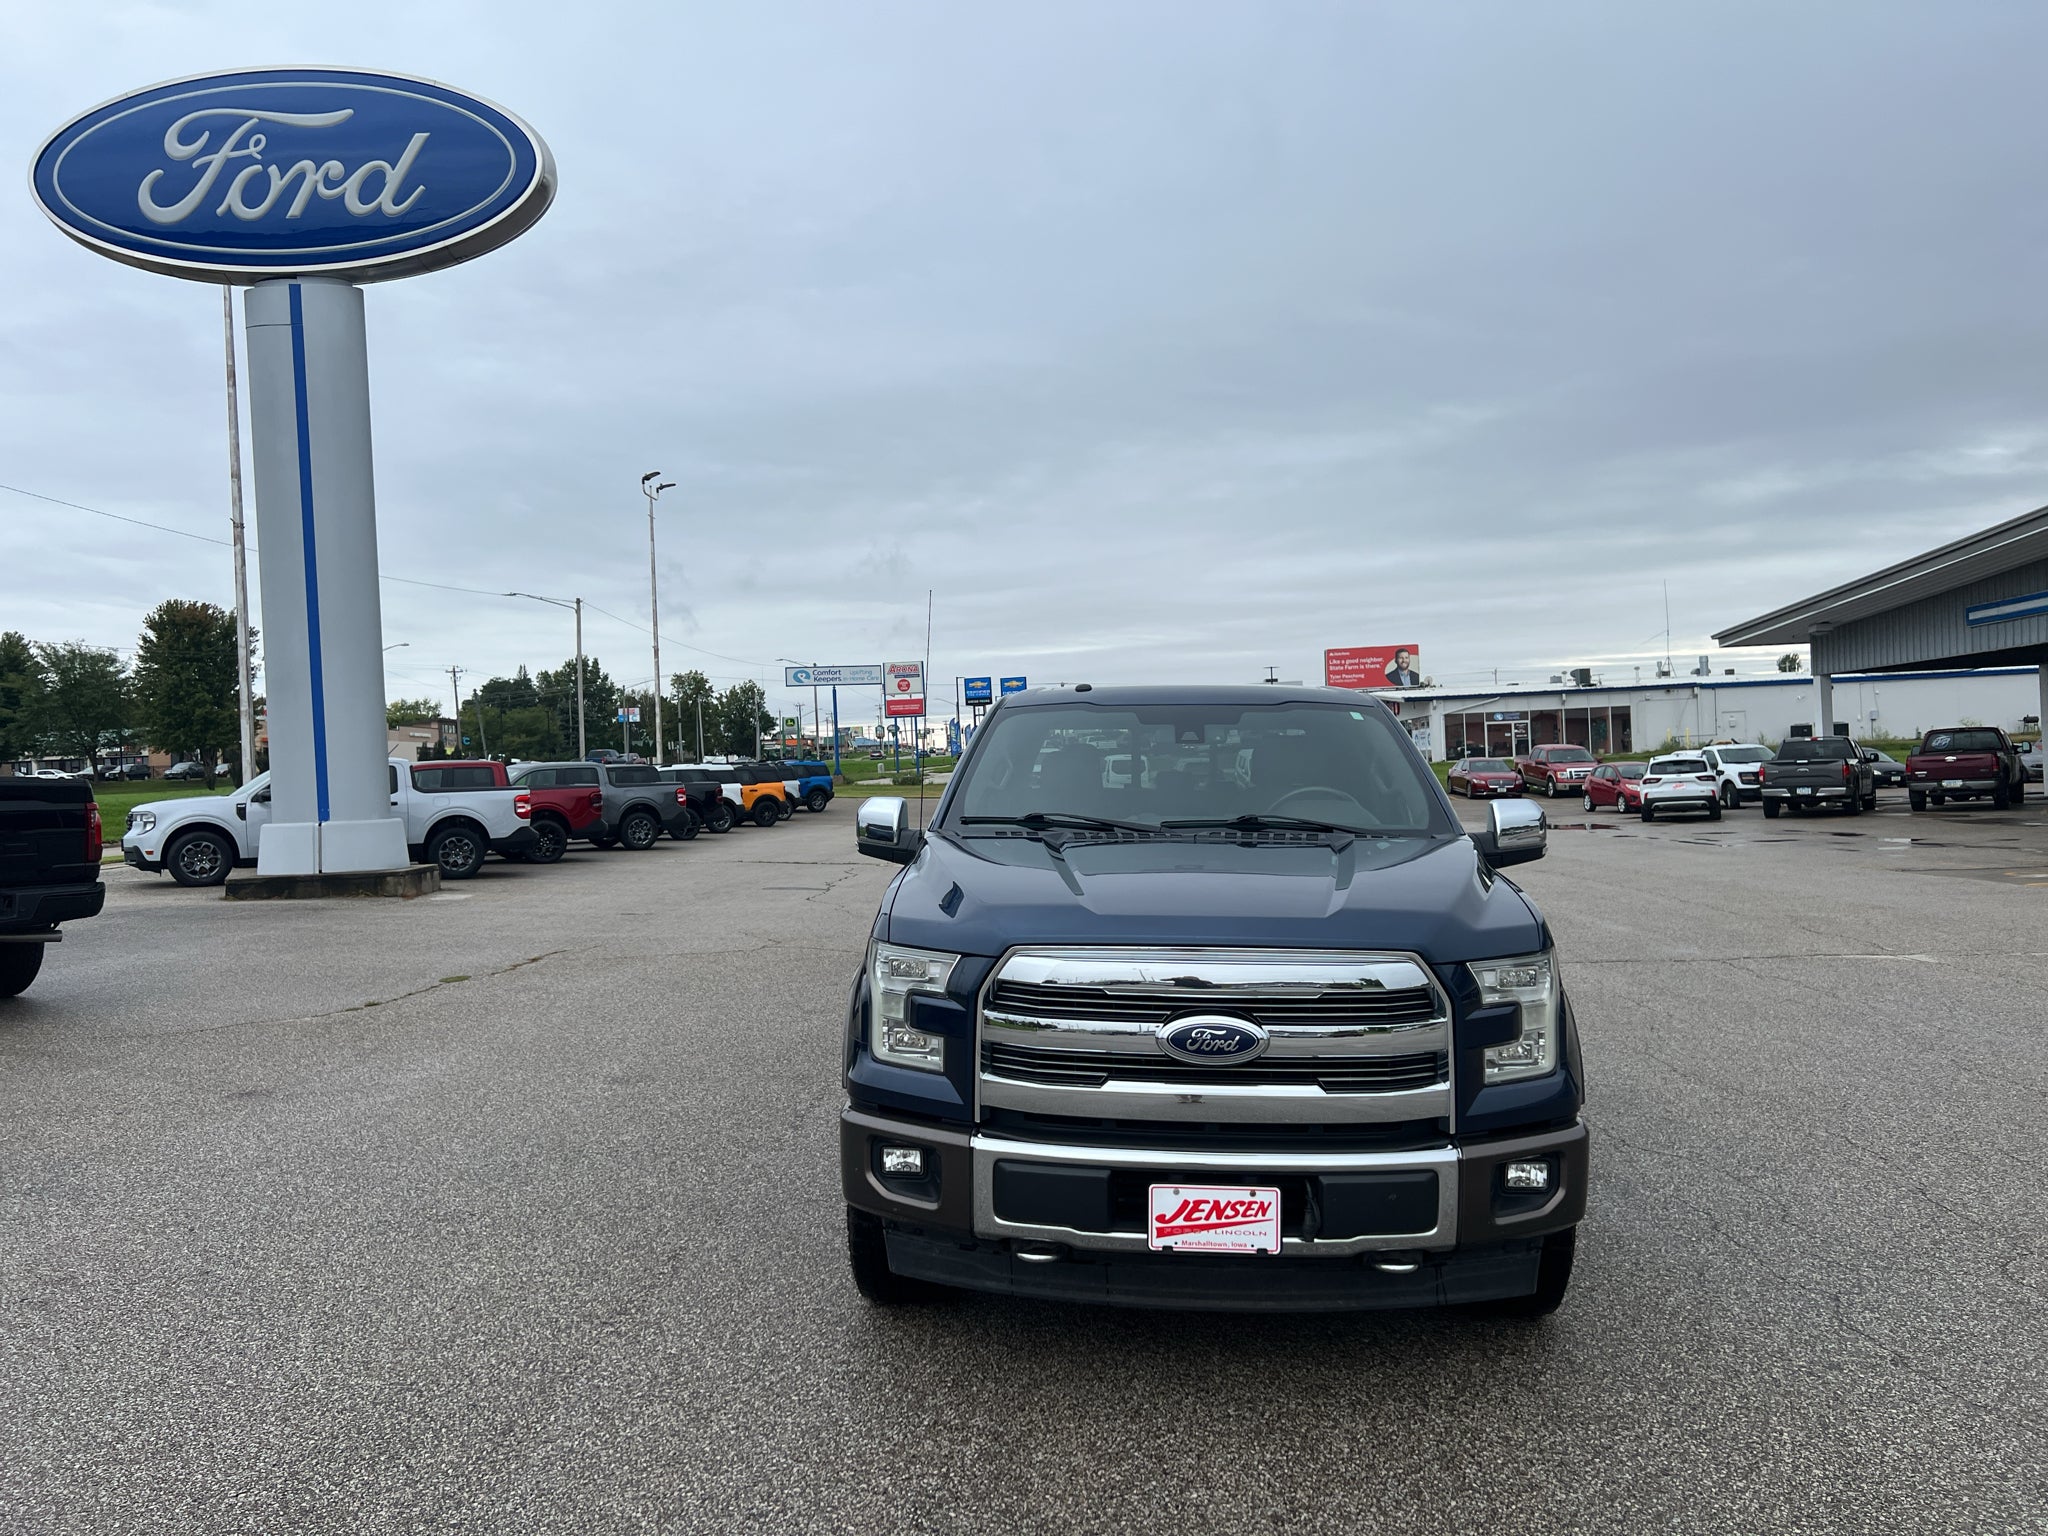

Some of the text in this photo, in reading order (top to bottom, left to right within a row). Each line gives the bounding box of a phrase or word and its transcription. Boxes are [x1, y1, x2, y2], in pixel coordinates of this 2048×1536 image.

[137, 108, 431, 225] Ford
[813, 675, 842, 683] Keepers
[1186, 1028, 1240, 1052] Ford
[1155, 1199, 1272, 1224] JENSEN
[1163, 1227, 1202, 1235] FORD
[1181, 1239, 1248, 1249] Marshalltown, Iowa
